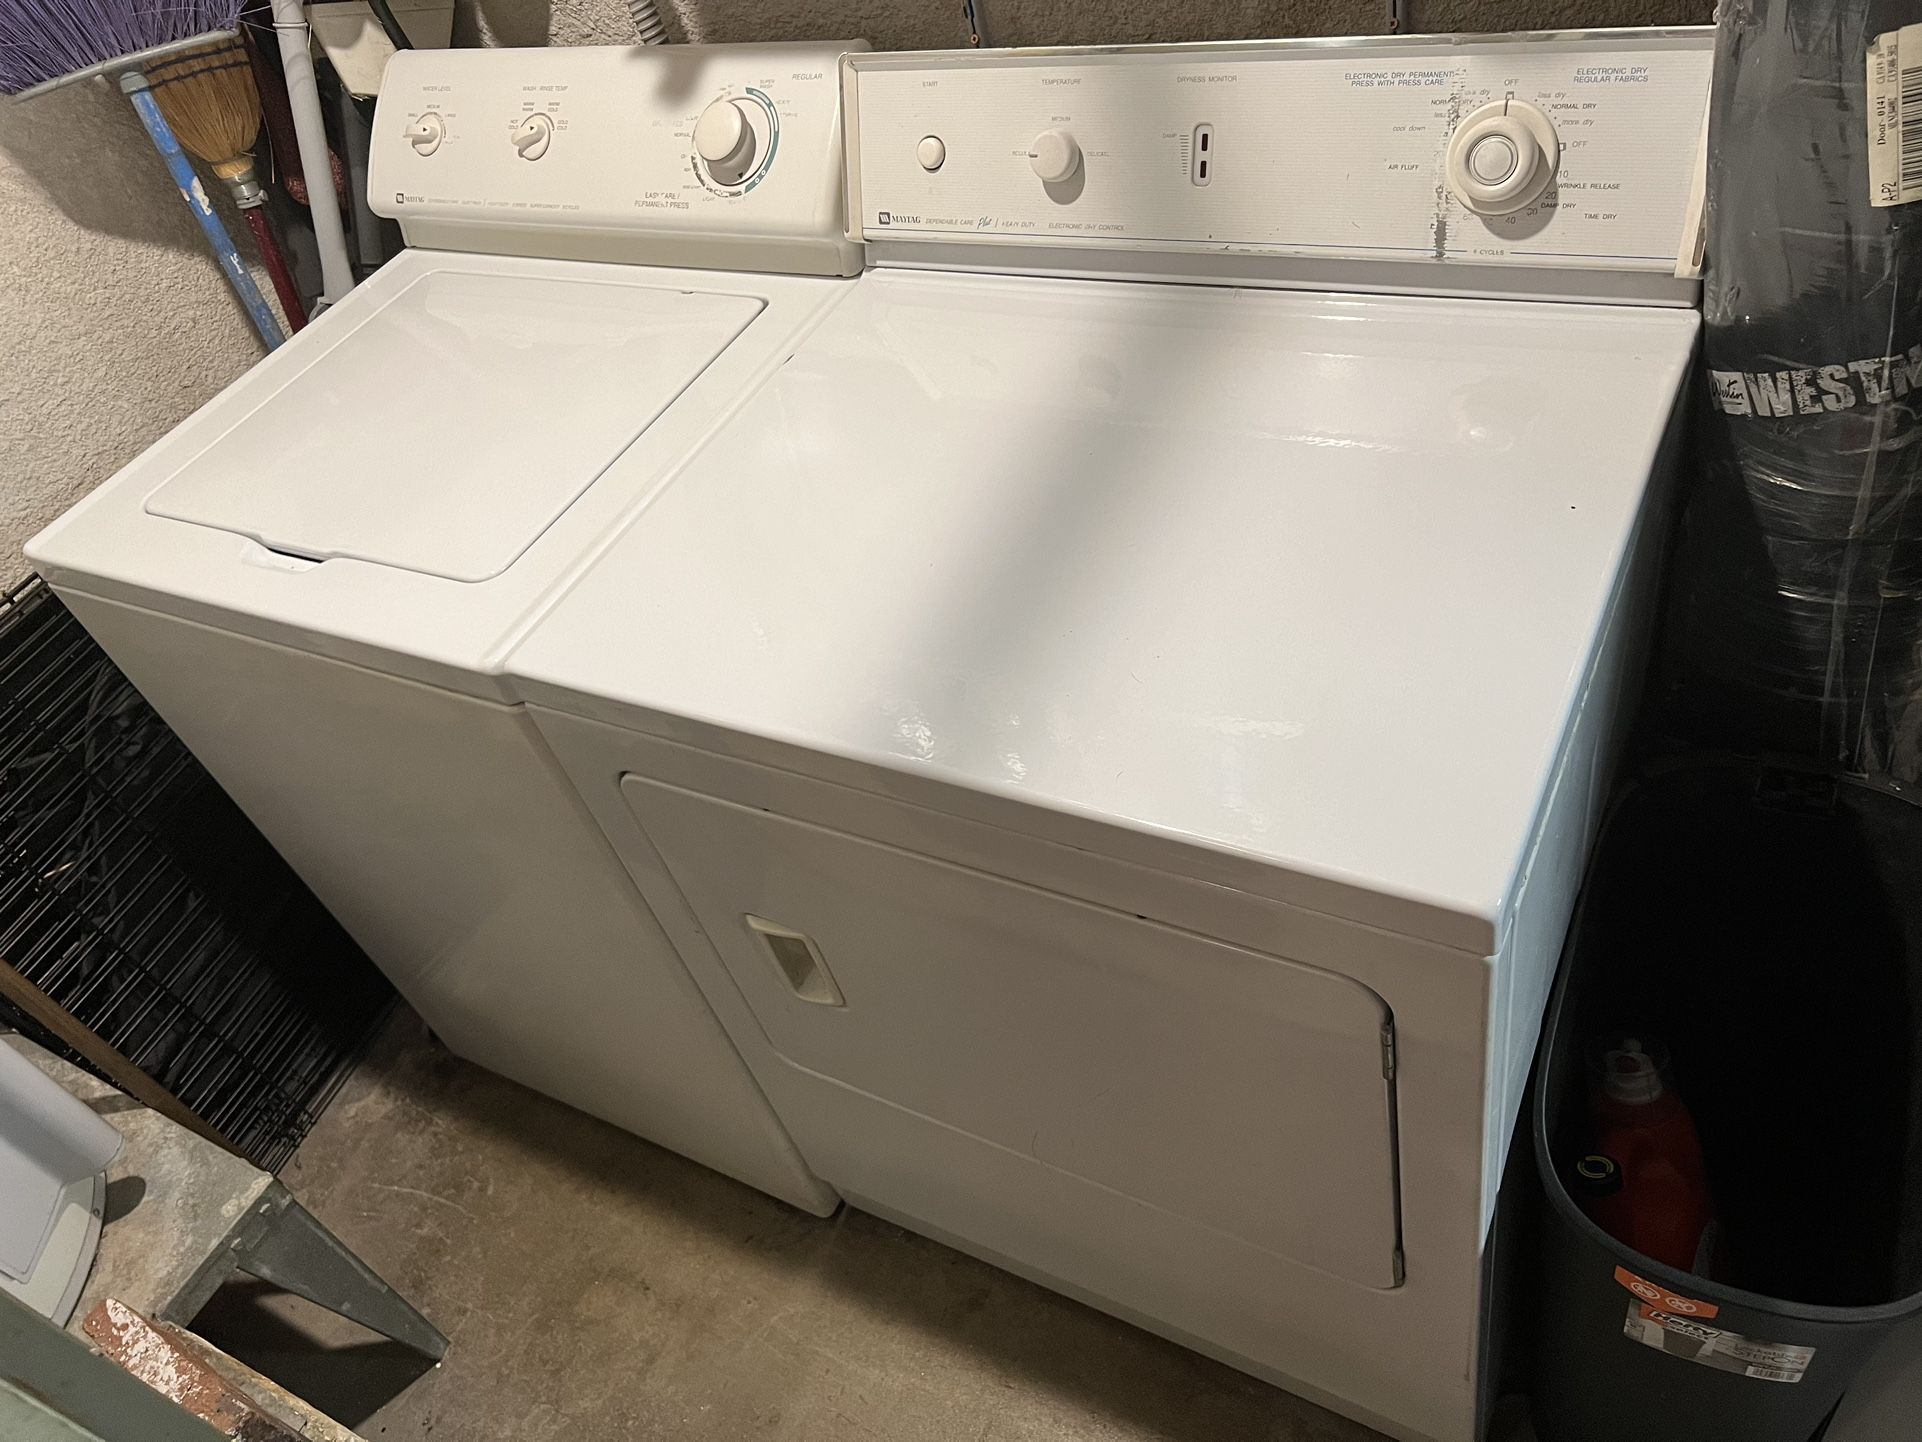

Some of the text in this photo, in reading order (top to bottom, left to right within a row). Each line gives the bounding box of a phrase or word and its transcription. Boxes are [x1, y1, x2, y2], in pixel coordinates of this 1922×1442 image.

[1409, 71, 1454, 79] PERMANENT
[1555, 91, 1566, 100] dry
[1876, 95, 1886, 116] 0141
[1583, 119, 1595, 127] dry
[1571, 140, 1588, 148] OFF
[1545, 191, 1557, 200] 20
[669, 201, 689, 209] PRESS
[891, 215, 921, 224] MAYTAG
